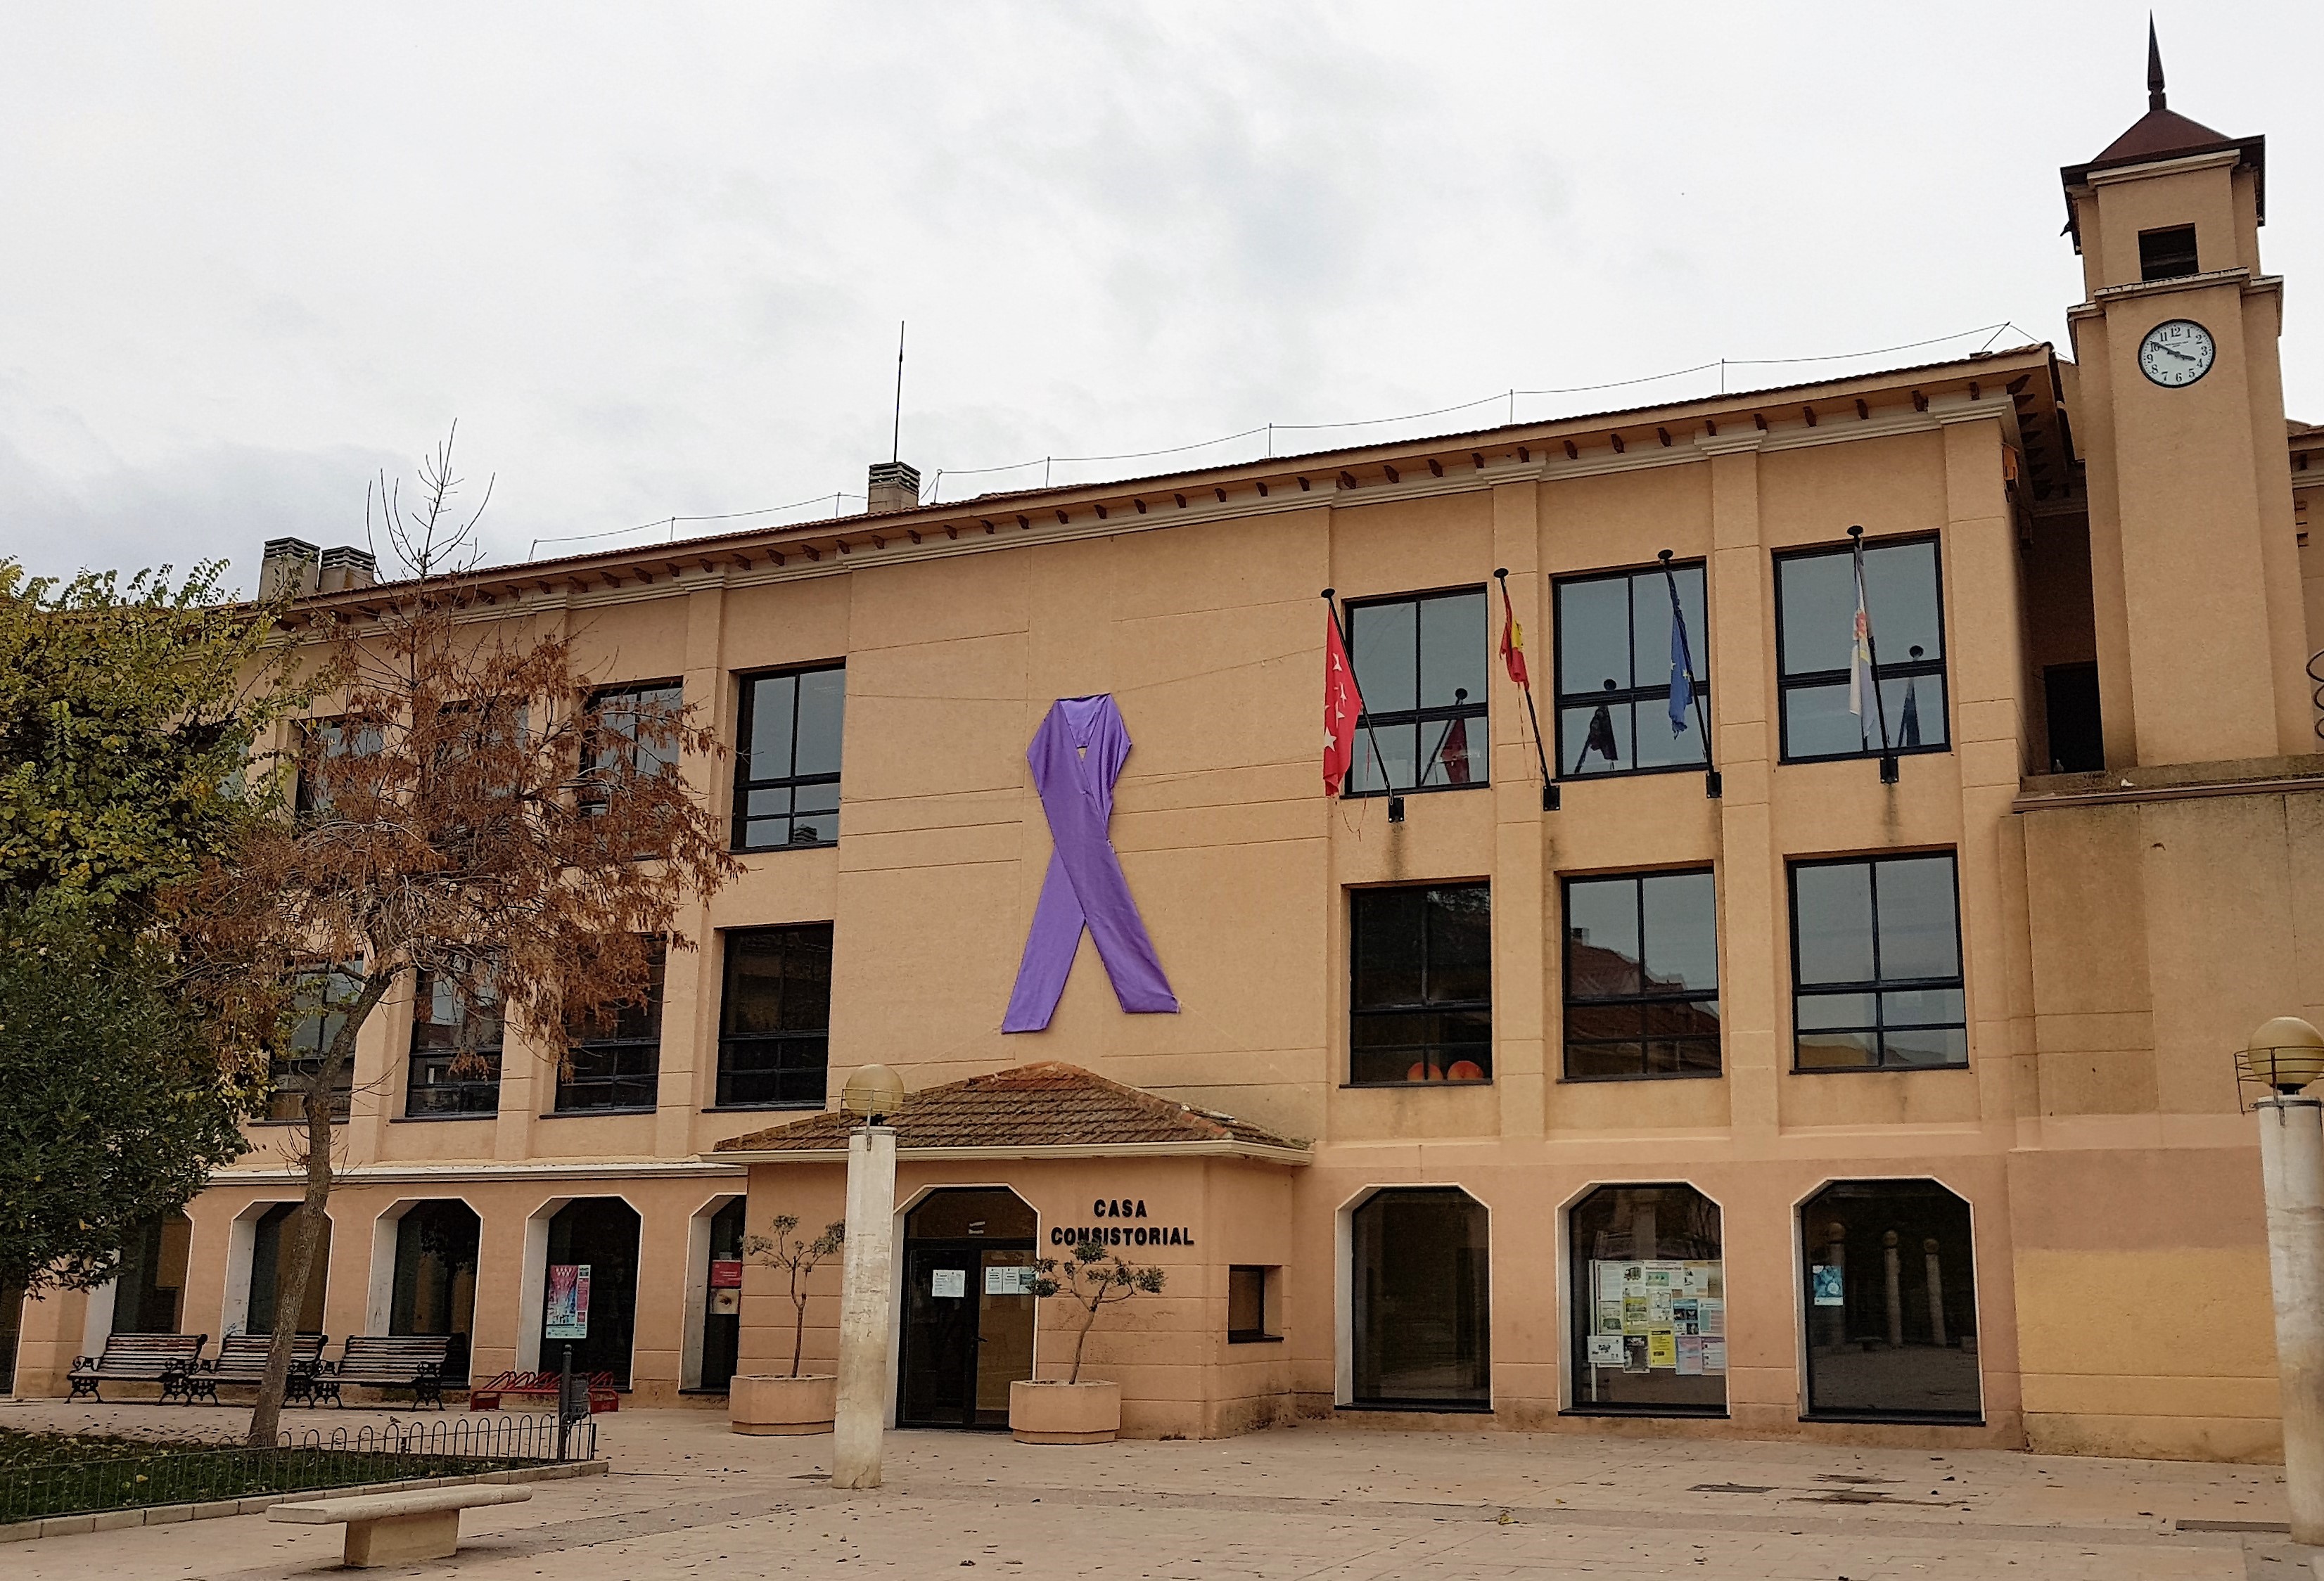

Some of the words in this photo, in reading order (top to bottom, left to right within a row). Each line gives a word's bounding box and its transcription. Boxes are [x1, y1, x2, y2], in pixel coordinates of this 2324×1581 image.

[2160, 332, 2167, 342] 11
[2171, 327, 2181, 337] 12
[2186, 328, 2191, 338] 1
[2195, 334, 2202, 344] 2
[2150, 343, 2160, 352] 10
[2201, 346, 2208, 356] 3
[2147, 354, 2153, 364] 9
[2197, 358, 2203, 368] 4
[2152, 364, 2159, 374] 8
[2188, 368, 2195, 378] 5
[2162, 371, 2168, 380] 7
[2175, 373, 2182, 382] 6
[1094, 1198, 1147, 1218] CASA
[1050, 1227, 1194, 1246] CONSISTORIAL
